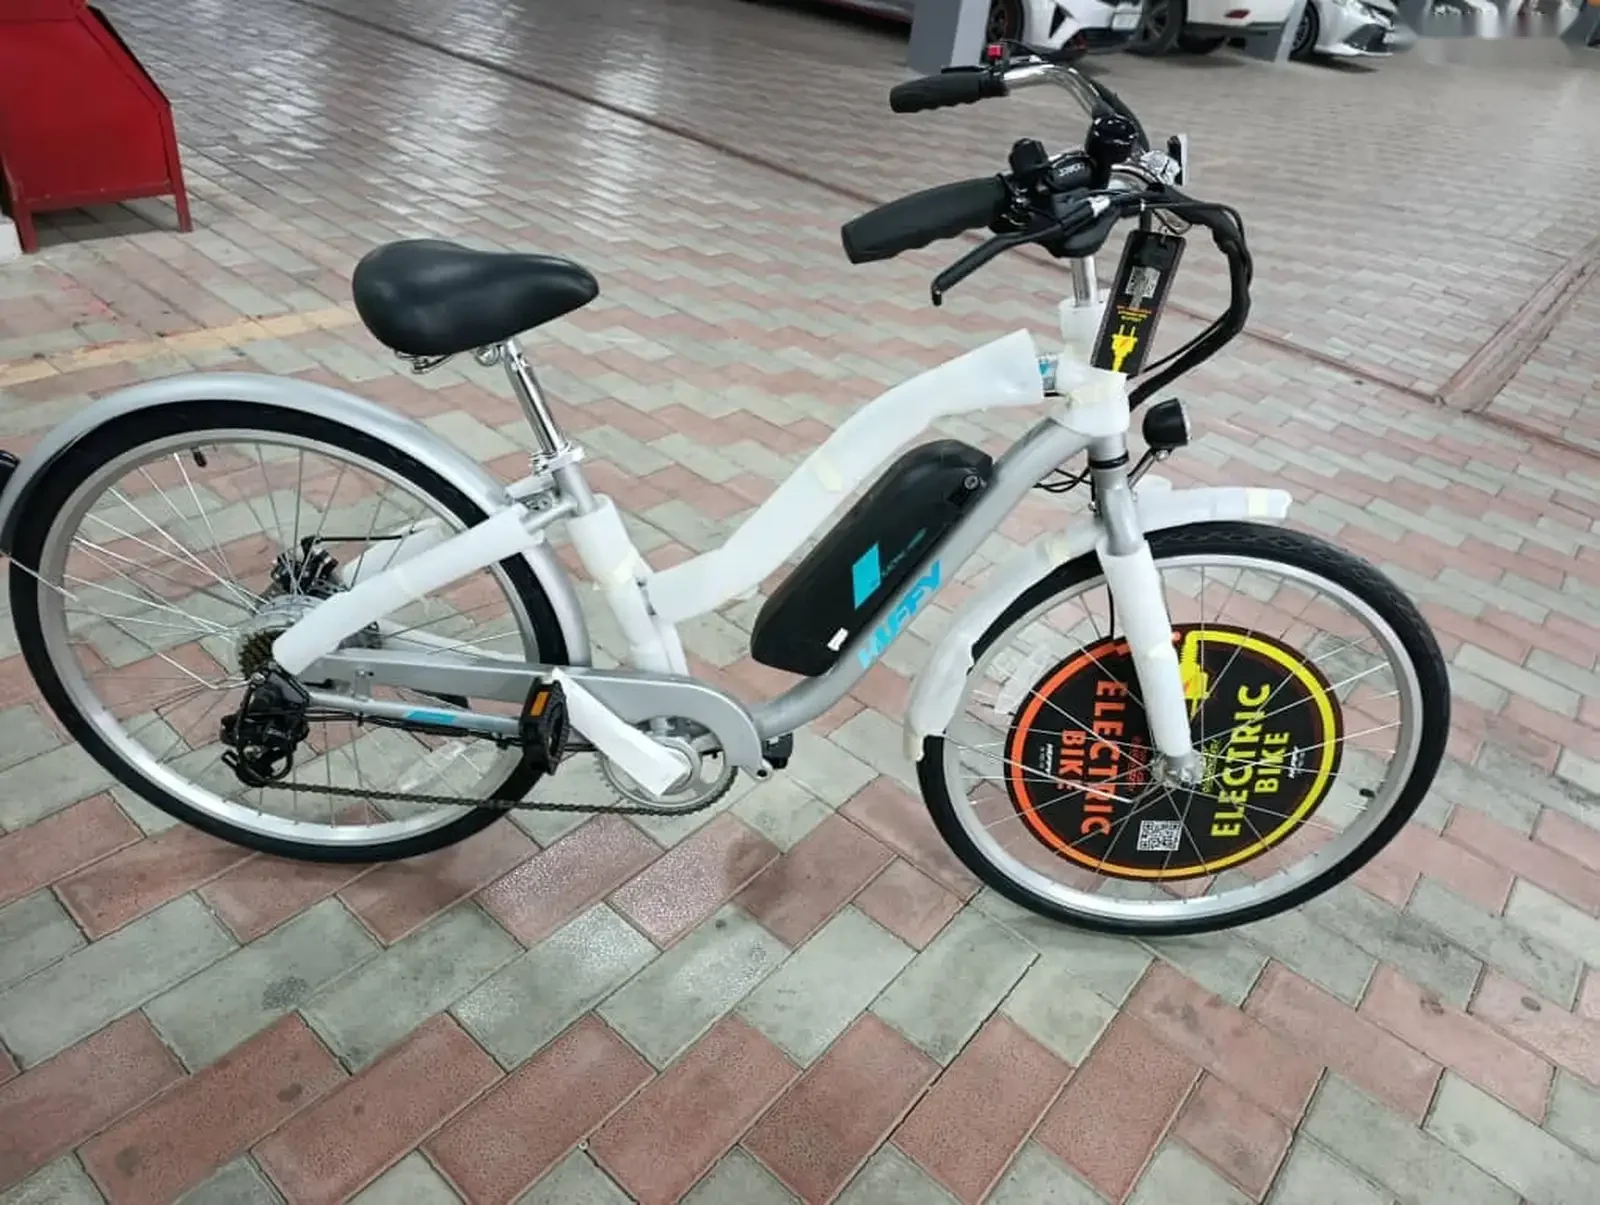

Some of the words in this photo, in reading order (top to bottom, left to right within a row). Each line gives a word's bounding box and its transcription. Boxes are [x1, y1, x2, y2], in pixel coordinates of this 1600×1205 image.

[1081, 680, 1128, 836] ELECTRIC
[1211, 683, 1271, 837] ELECTRIC
[1254, 731, 1290, 795] BIKE
